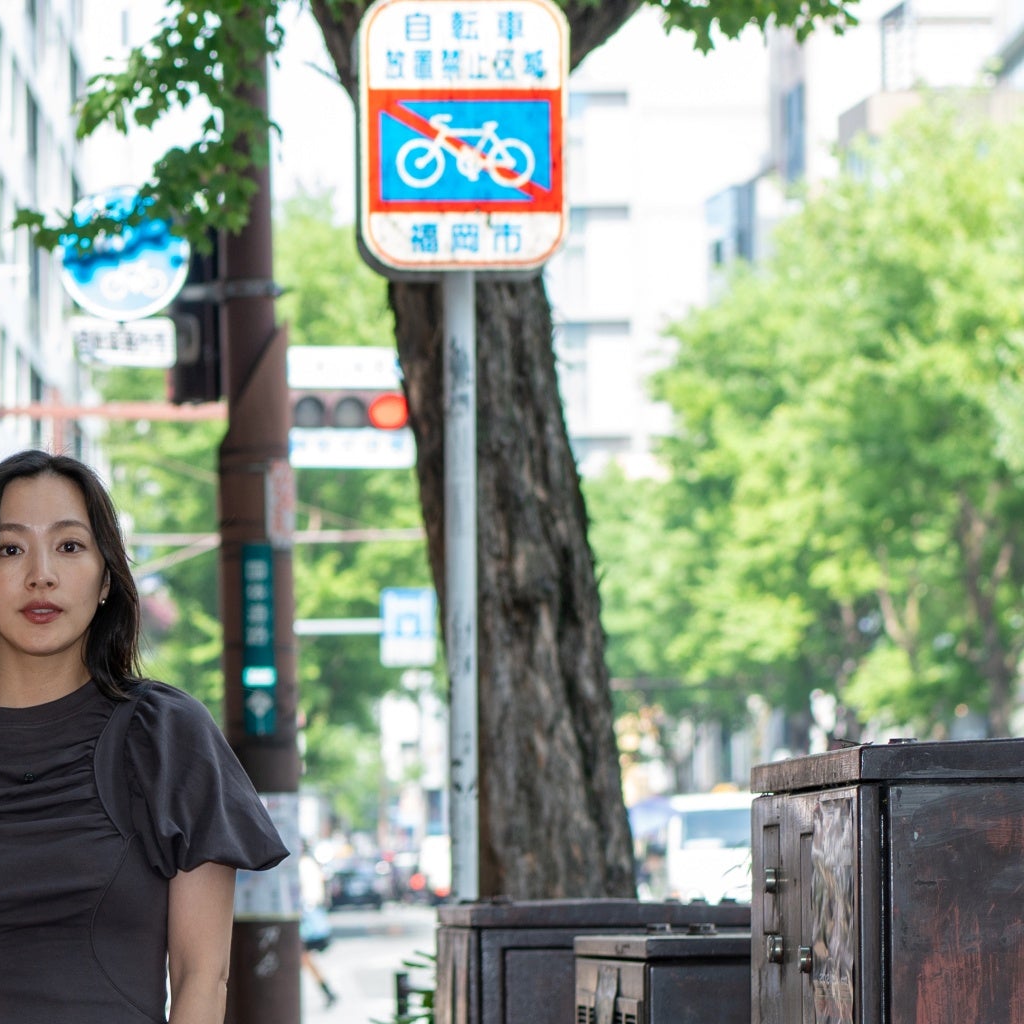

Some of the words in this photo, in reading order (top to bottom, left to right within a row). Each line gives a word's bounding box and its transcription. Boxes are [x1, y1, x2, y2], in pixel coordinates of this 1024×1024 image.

[405, 11, 524, 42] 自転車
[386, 49, 546, 81] 放置禁止区域
[411, 223, 522, 254] 福岡市
